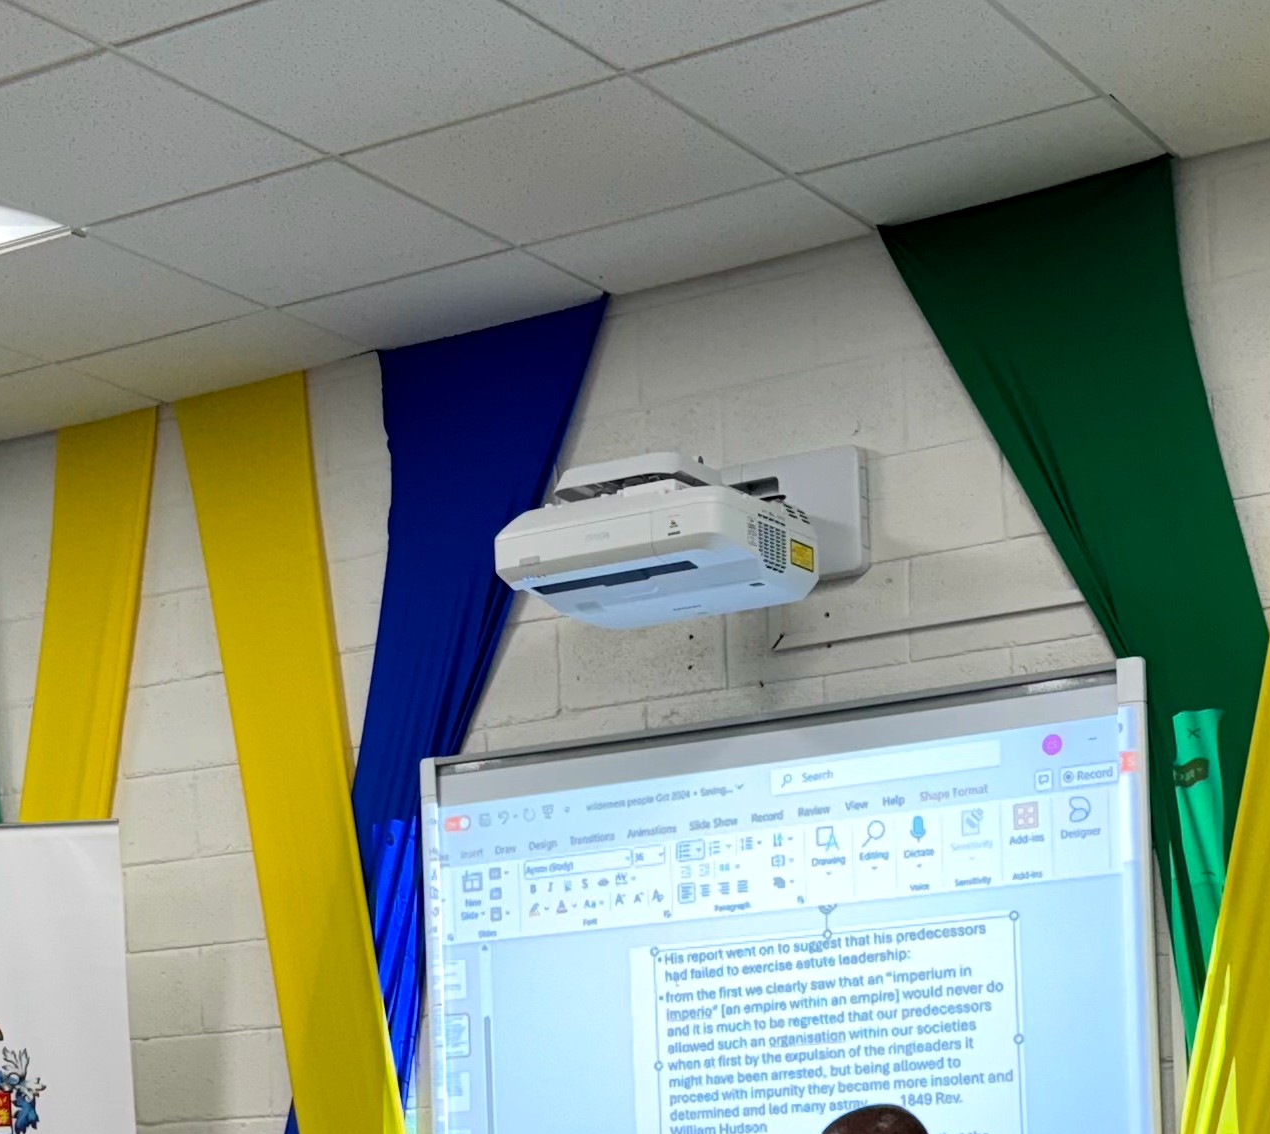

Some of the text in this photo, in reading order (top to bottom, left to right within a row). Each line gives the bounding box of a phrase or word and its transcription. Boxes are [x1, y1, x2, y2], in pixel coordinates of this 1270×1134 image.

[802, 769, 834, 782] Search
[1076, 766, 1114, 780] Record
[528, 840, 558, 852] Design
[569, 831, 615, 846] Transitions
[627, 824, 678, 839] Animations
[689, 820, 710, 832] Slide
[713, 817, 738, 828] Show
[751, 810, 784, 823] Record
[798, 806, 830, 818] Review
[845, 800, 869, 811] View
[882, 795, 905, 807] Help
[920, 790, 950, 802] Shape
[952, 784, 988, 798] Format
[1060, 828, 1102, 840] Designer
[1009, 834, 1045, 845] Add-ins
[812, 856, 846, 868] Drawing
[859, 851, 889, 862] Editing
[665, 925, 986, 964] His report went on to suggest that his predecessors
[665, 949, 911, 981] had failed to exercise astute leadership:
[666, 989, 693, 1002] from
[696, 986, 716, 999] the
[718, 984, 742, 998] first
[745, 985, 763, 995] we
[765, 978, 807, 994] clearly
[810, 979, 836, 990] saw
[838, 974, 864, 987] that
[867, 975, 883, 985] an
[959, 964, 972, 977] in
[721, 1001, 740, 1016] [an
[743, 998, 786, 1014] empire
[789, 994, 828, 1008] within
[830, 995, 846, 1005] an
[850, 987, 899, 1006] empire]
[902, 984, 942, 1000] would
[946, 984, 982, 996] never
[986, 980, 1004, 993] do
[667, 1002, 992, 1037] and it is much to be regretted that our predecessors
[667, 1019, 977, 1054] allowed such an organisation within our societies
[667, 1036, 974, 1070] when at first by the expulsion of the ringleaders it
[668, 1057, 962, 1090] might have been arrested, but being allowed to
[669, 1069, 1014, 1106] proceed with impunity they became more insolent and
[669, 1104, 739, 1120] determined
[742, 1102, 765, 1116] and
[768, 1101, 787, 1114] led
[791, 1102, 825, 1115] many
[899, 1092, 932, 1107] 1849
[935, 1091, 964, 1104] Rev.
[719, 1121, 768, 1134] Hudson
